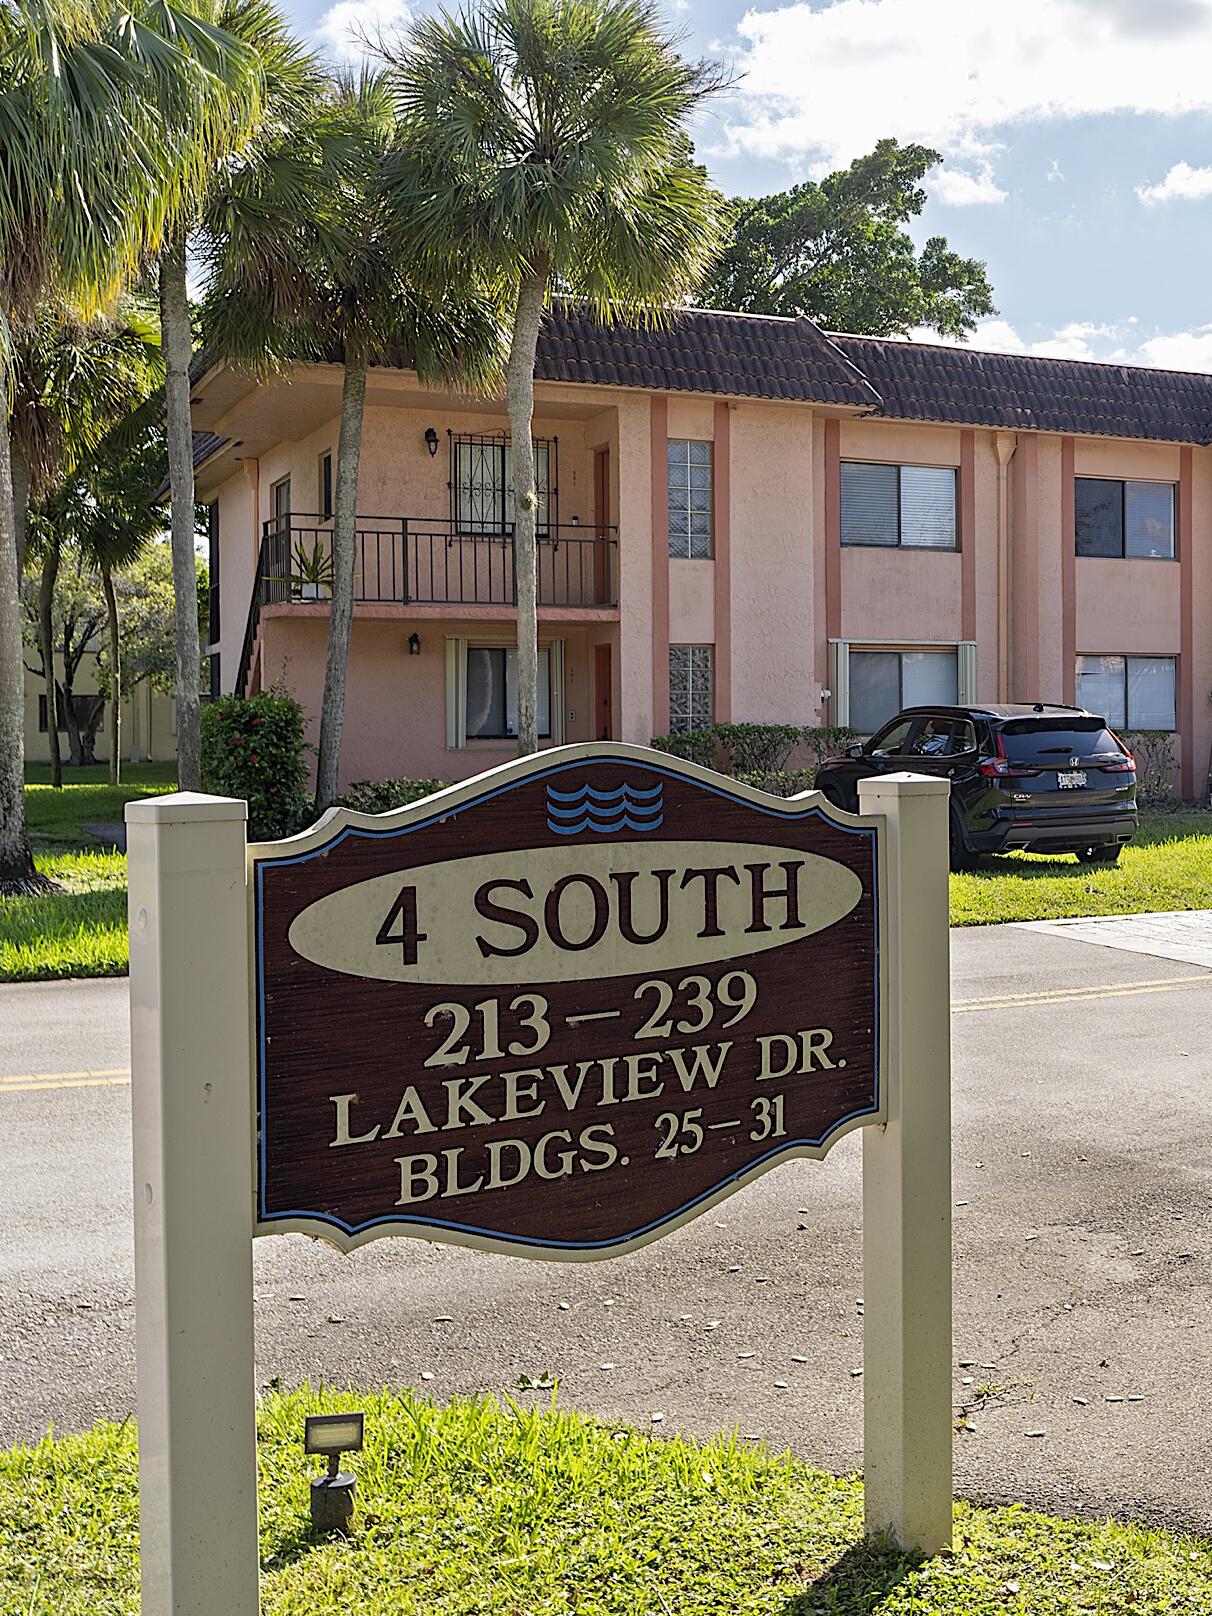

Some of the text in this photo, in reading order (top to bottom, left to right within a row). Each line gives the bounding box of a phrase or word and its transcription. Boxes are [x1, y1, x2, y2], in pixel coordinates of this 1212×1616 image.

[375, 859, 807, 965] 4 SOUTH
[328, 1027, 847, 1148] LAKEVIEW DR.
[394, 1123, 630, 1206] BLDGS.
